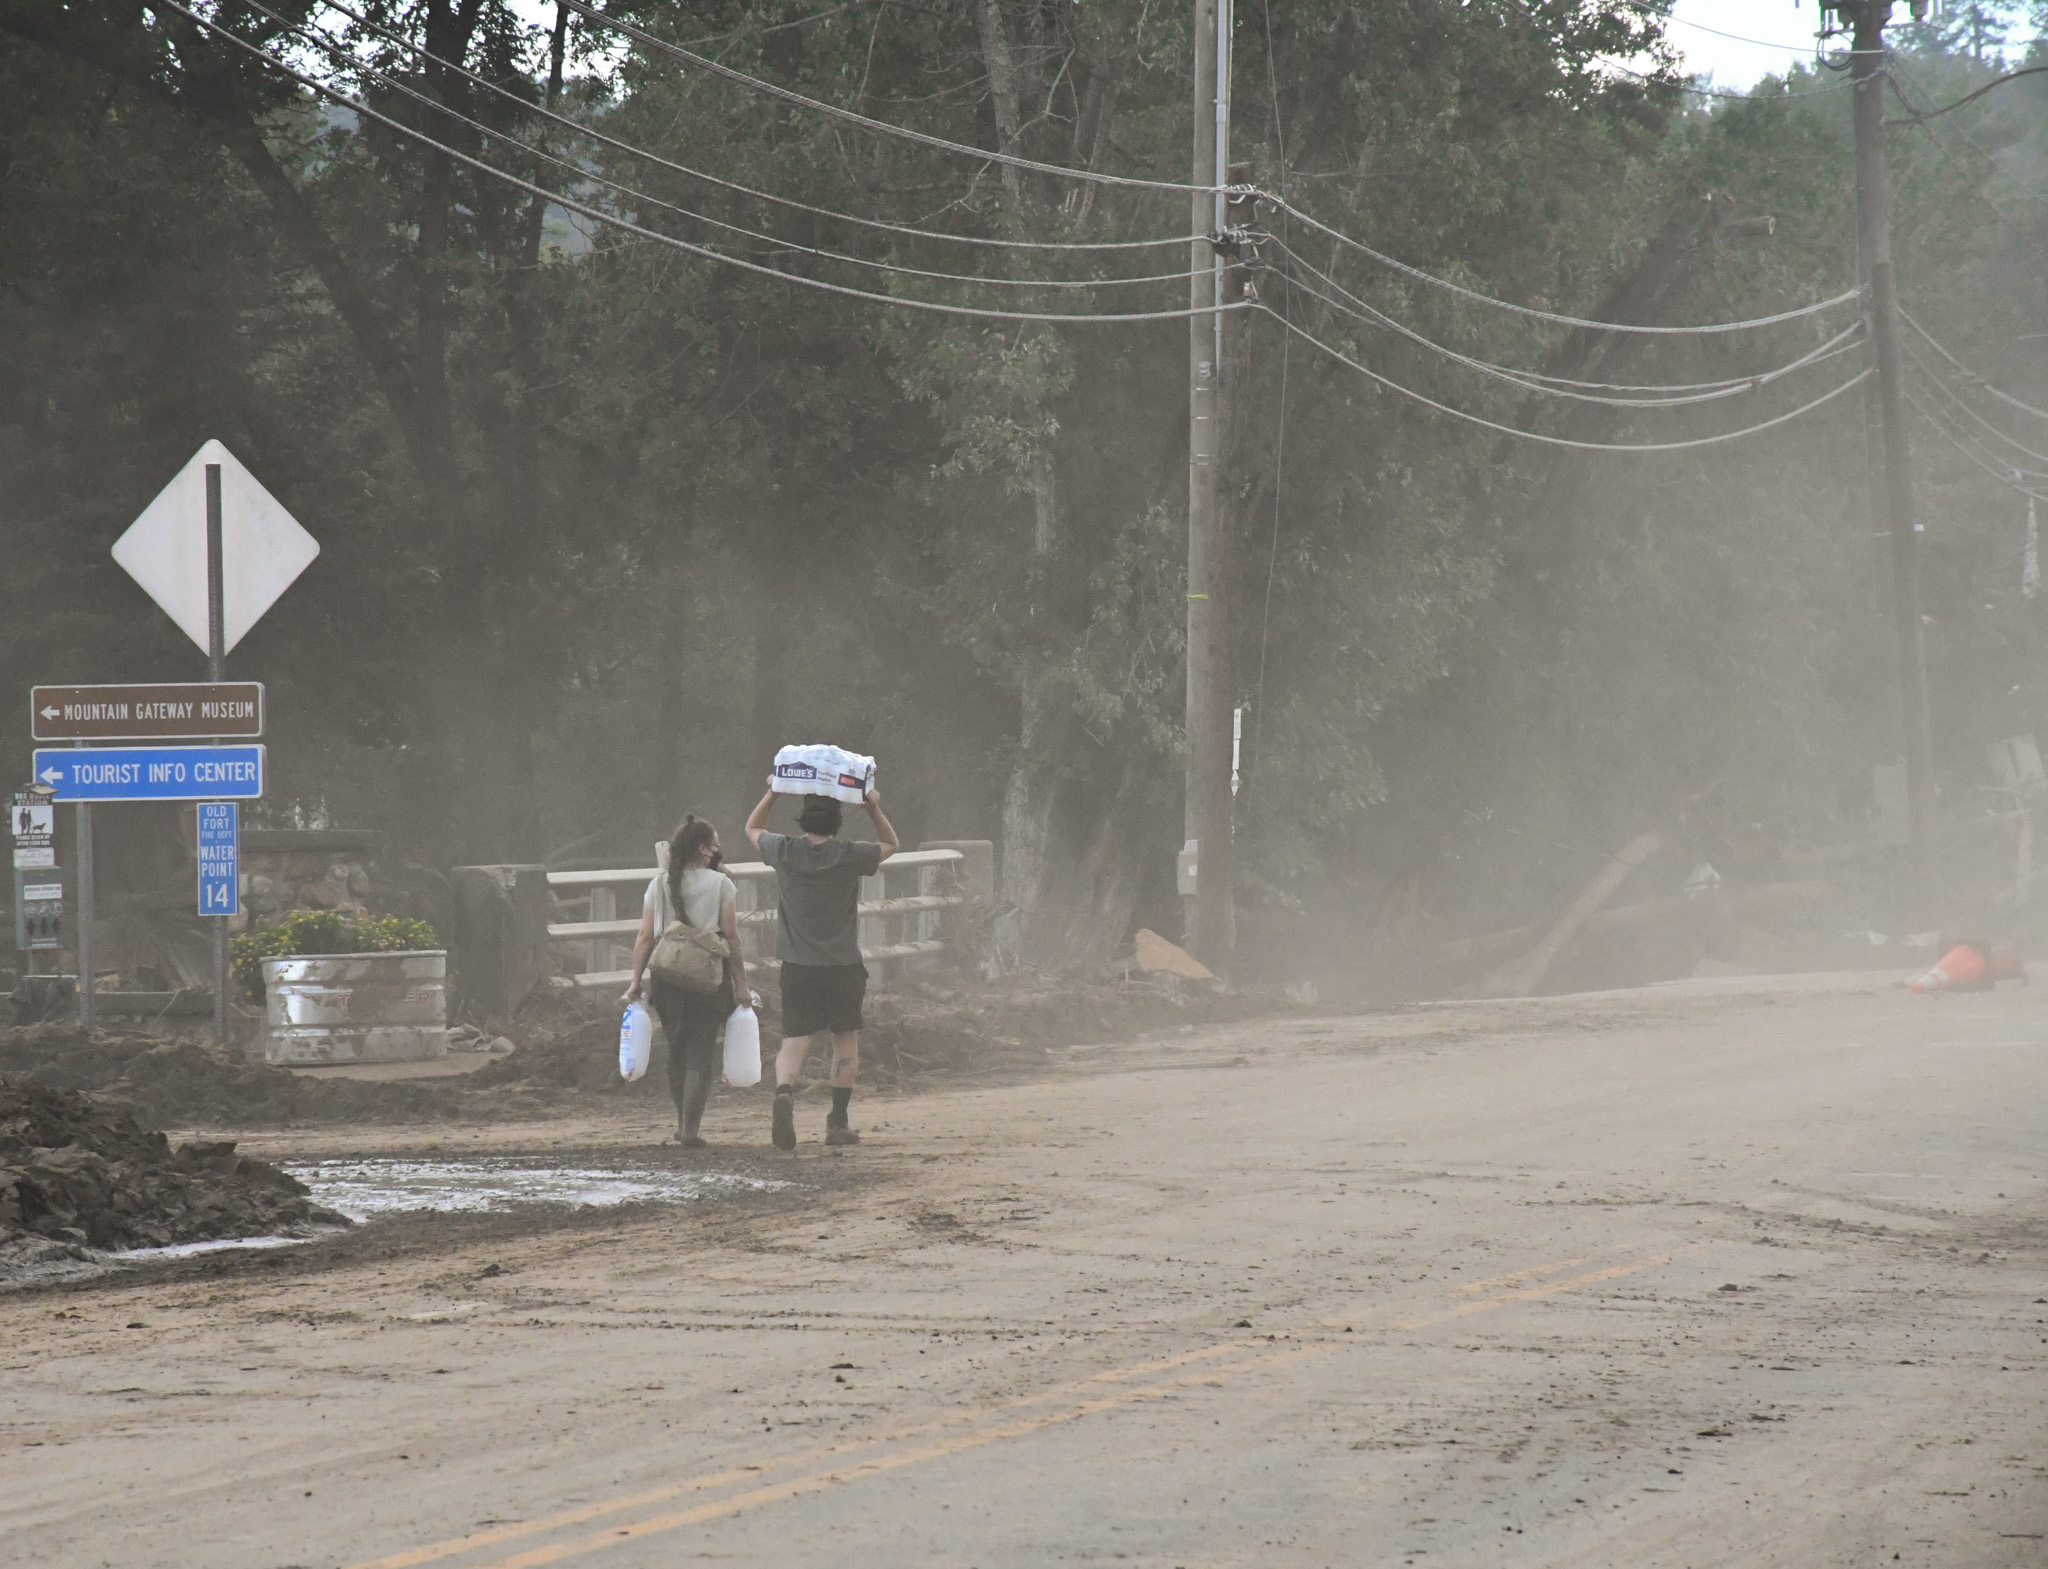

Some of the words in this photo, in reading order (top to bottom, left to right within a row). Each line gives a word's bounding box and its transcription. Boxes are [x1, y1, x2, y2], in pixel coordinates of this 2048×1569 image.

[64, 703, 129, 721] MOUNTAIN
[136, 702, 194, 720] GATEWAY
[201, 701, 254, 719] MUSEUM
[72, 763, 141, 784] TOURIST
[149, 763, 186, 783] INFO
[194, 761, 256, 782] CENTER
[781, 766, 814, 778] LOWE'S
[206, 805, 227, 817] OLD
[203, 818, 230, 830] FORT
[202, 830, 214, 839] FIRE
[217, 830, 232, 839] DEPT
[200, 845, 234, 861] WATER
[201, 862, 233, 877] POINT
[207, 883, 229, 908] 14
